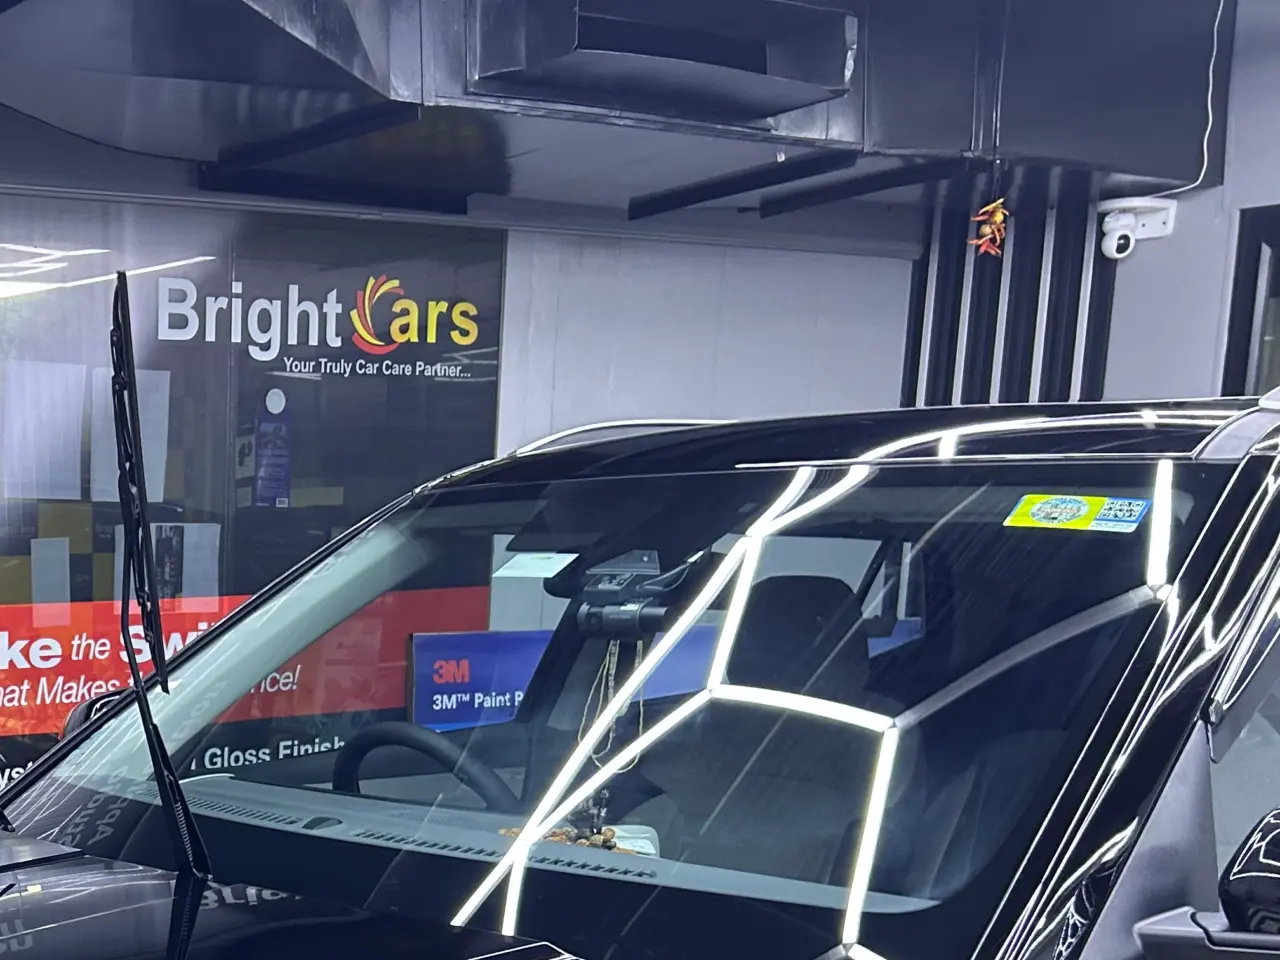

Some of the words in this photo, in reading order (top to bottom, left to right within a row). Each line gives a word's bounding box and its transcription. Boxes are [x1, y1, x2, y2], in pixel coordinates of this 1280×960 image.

[284, 357, 315, 372] Your
[319, 358, 353, 378] Truly
[355, 360, 379, 375] Car
[382, 360, 412, 376] Care
[416, 362, 471, 378] Partner...
[71, 633, 110, 661] the
[432, 659, 469, 684] 3M
[36, 675, 119, 706] Makes
[474, 692, 510, 708] Paint
[204, 746, 271, 769] Gloss
